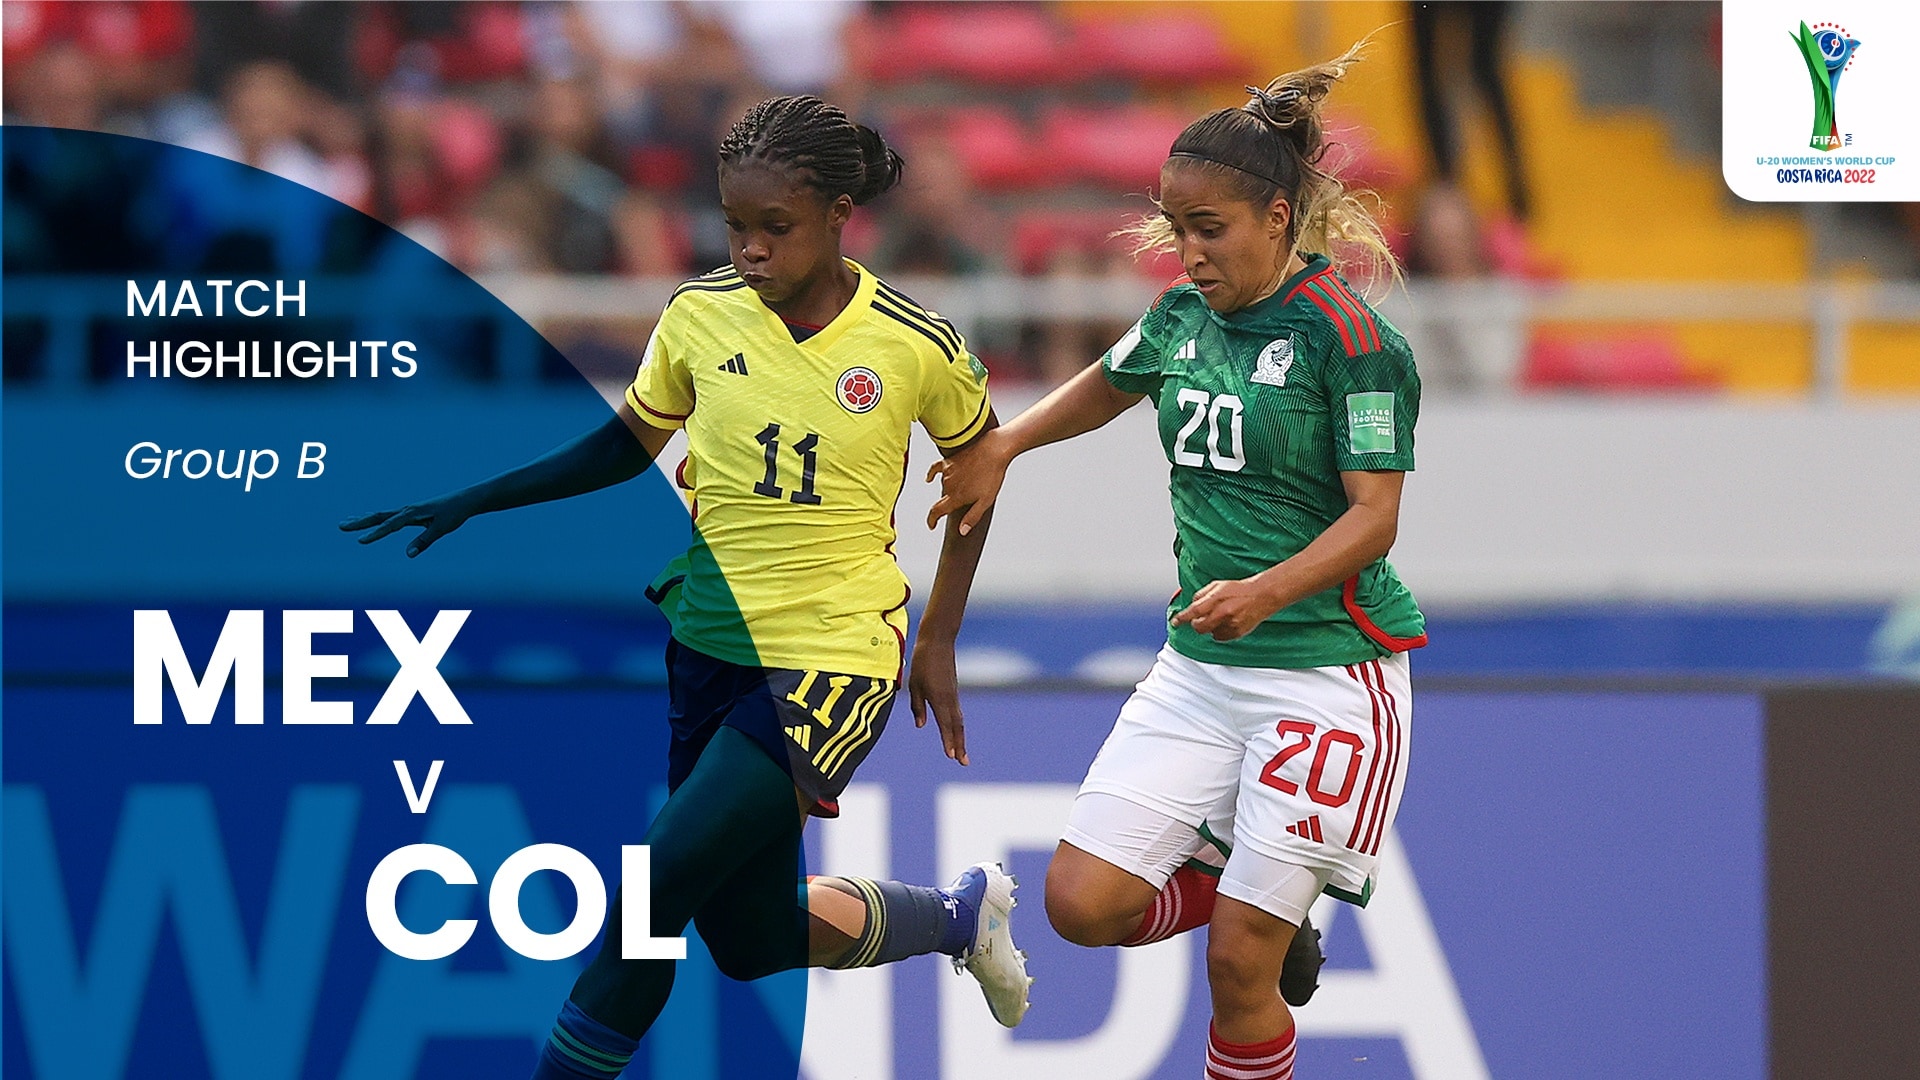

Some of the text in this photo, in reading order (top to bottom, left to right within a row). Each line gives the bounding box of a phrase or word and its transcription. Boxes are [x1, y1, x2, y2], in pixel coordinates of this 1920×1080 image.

[753, 422, 822, 505] 11
[1173, 387, 1247, 473] 20
[786, 669, 854, 729] 11
[1258, 719, 1366, 809] 20
[2, 782, 1491, 1080] WANDA
